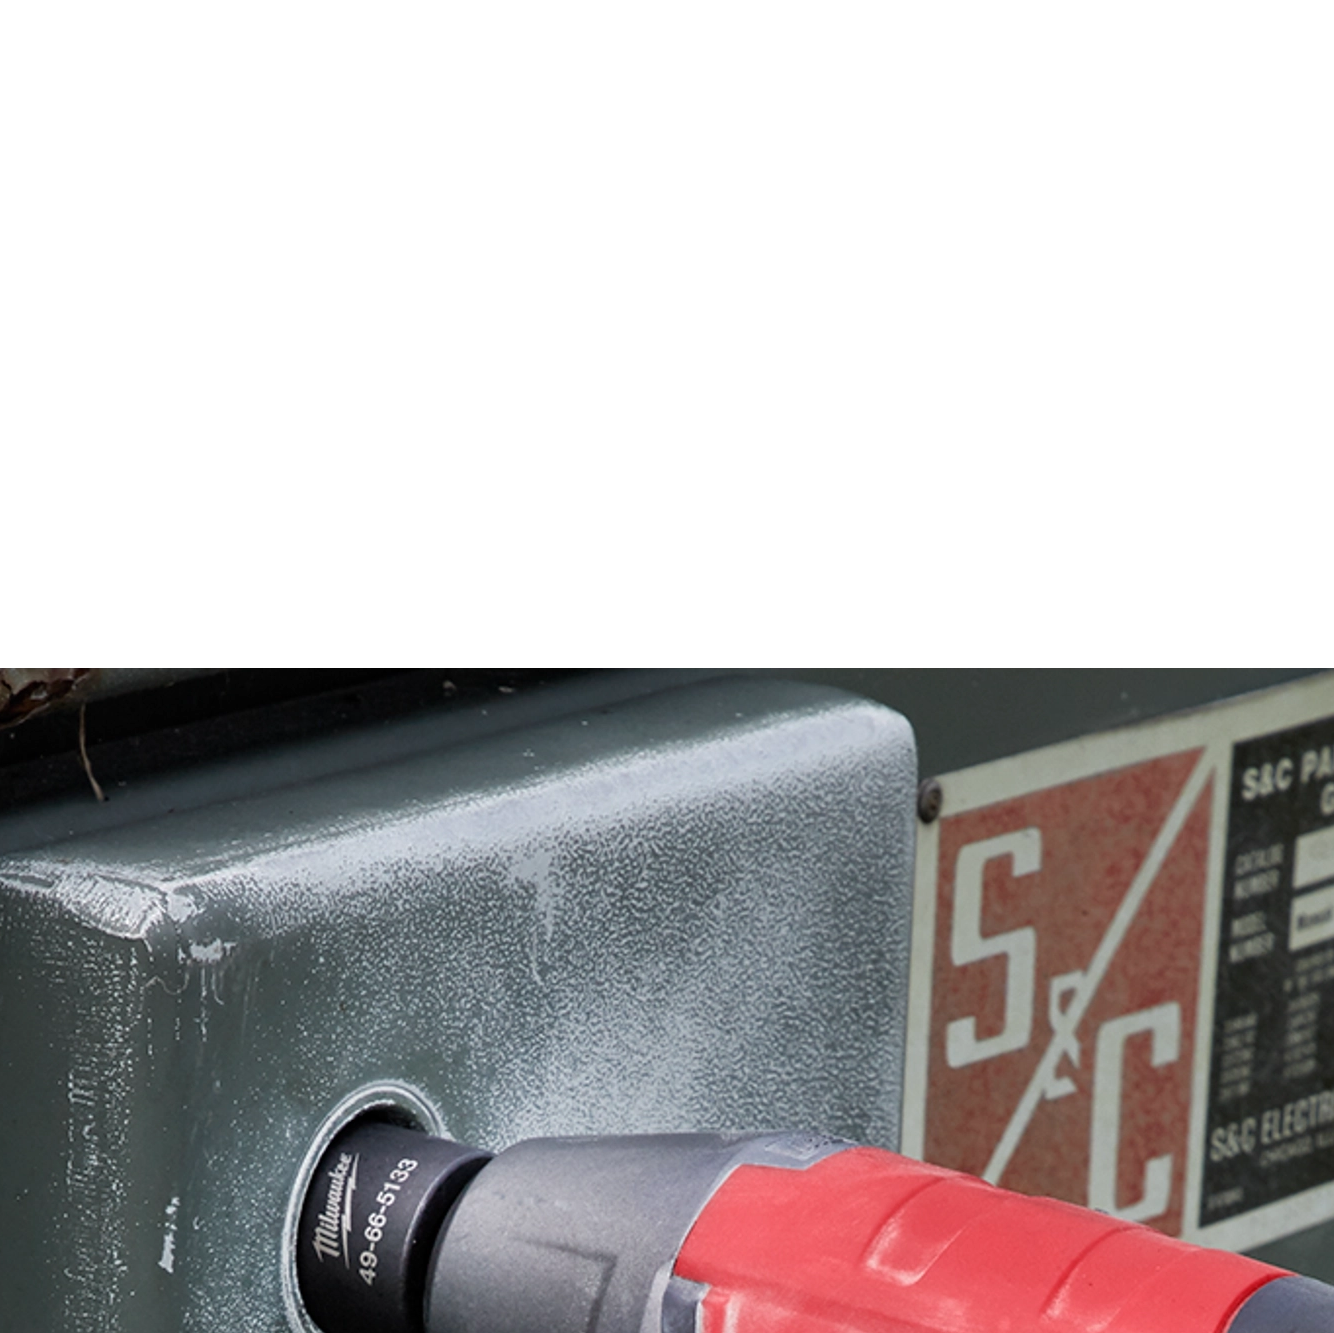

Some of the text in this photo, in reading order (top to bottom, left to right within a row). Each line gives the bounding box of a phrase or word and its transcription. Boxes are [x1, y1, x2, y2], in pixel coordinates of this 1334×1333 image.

[1241, 757, 1294, 801] S&C
[1210, 1117, 1258, 1162] S&C
[312, 1152, 353, 1263] Milwaukee
[358, 1157, 419, 1286] 49-66-5133
